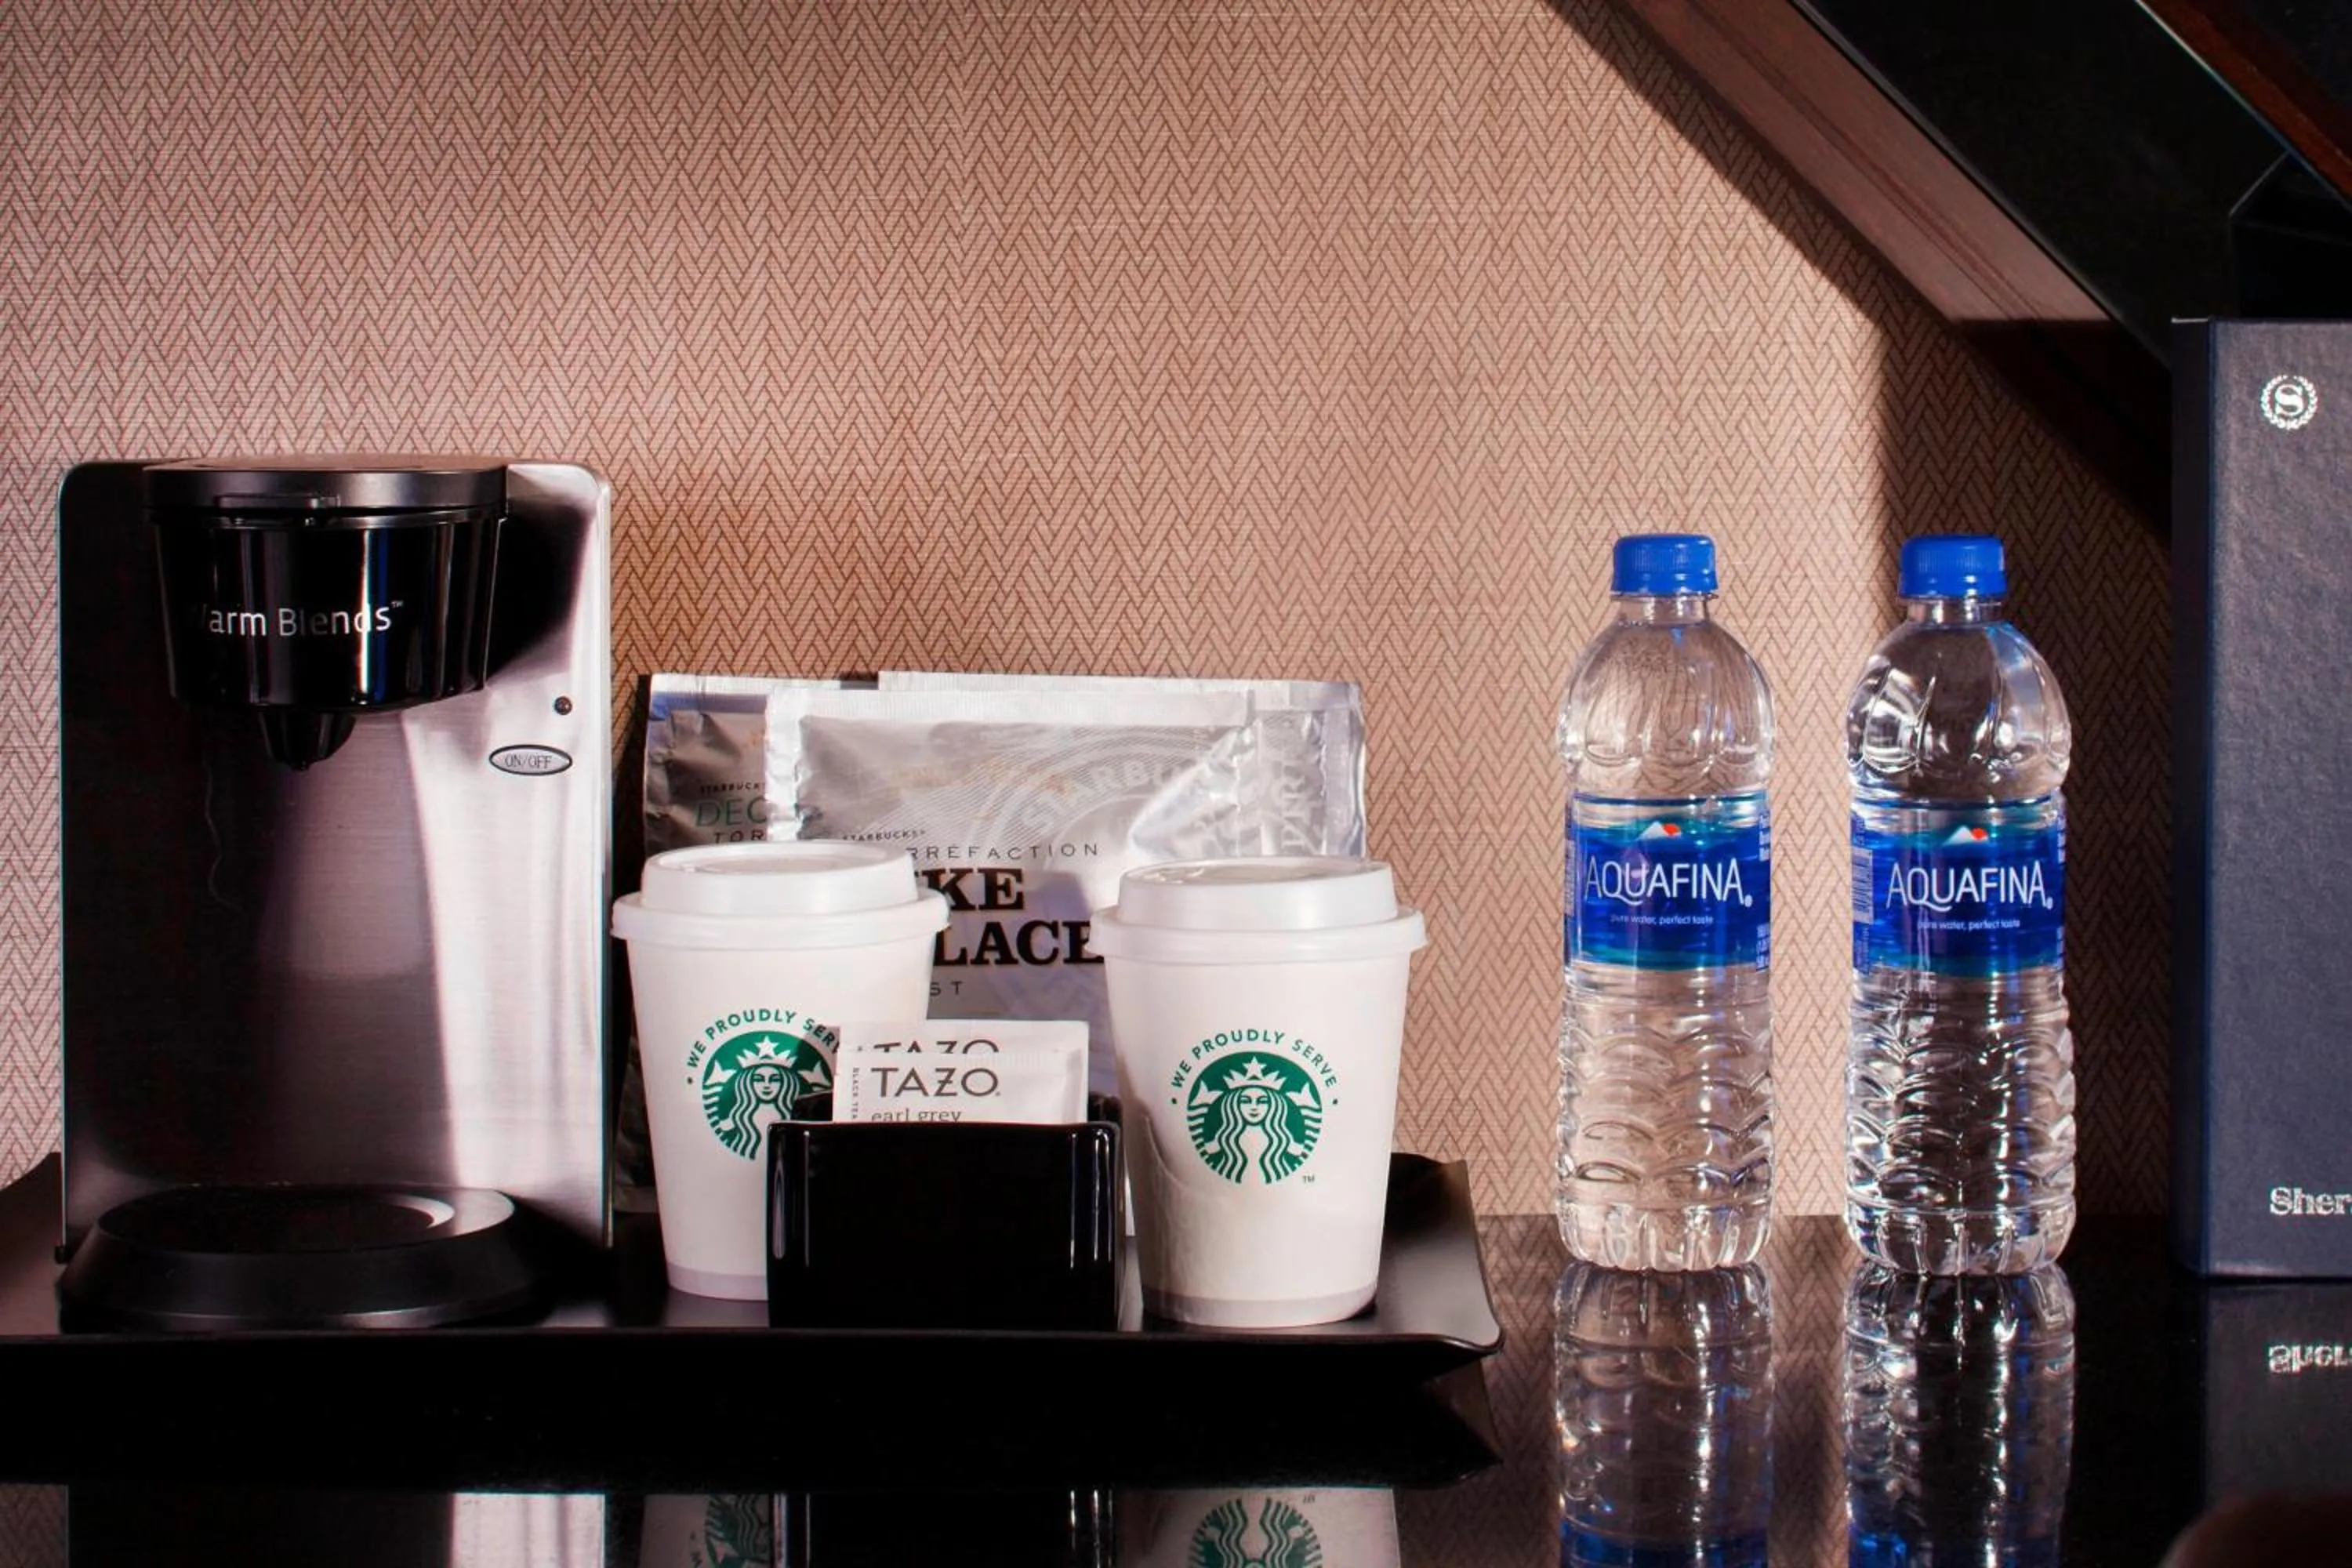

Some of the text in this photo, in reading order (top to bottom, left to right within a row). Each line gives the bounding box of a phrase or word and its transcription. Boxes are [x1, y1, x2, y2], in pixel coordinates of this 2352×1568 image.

[504, 754, 553, 768] ON/OFF
[914, 866, 1025, 911] KE
[687, 1040, 706, 1069] WE
[706, 1007, 797, 1041] PROUDLY
[1171, 1028, 1338, 1088] WE PROUDLY SERVE
[2269, 1186, 2352, 1215] Sher
